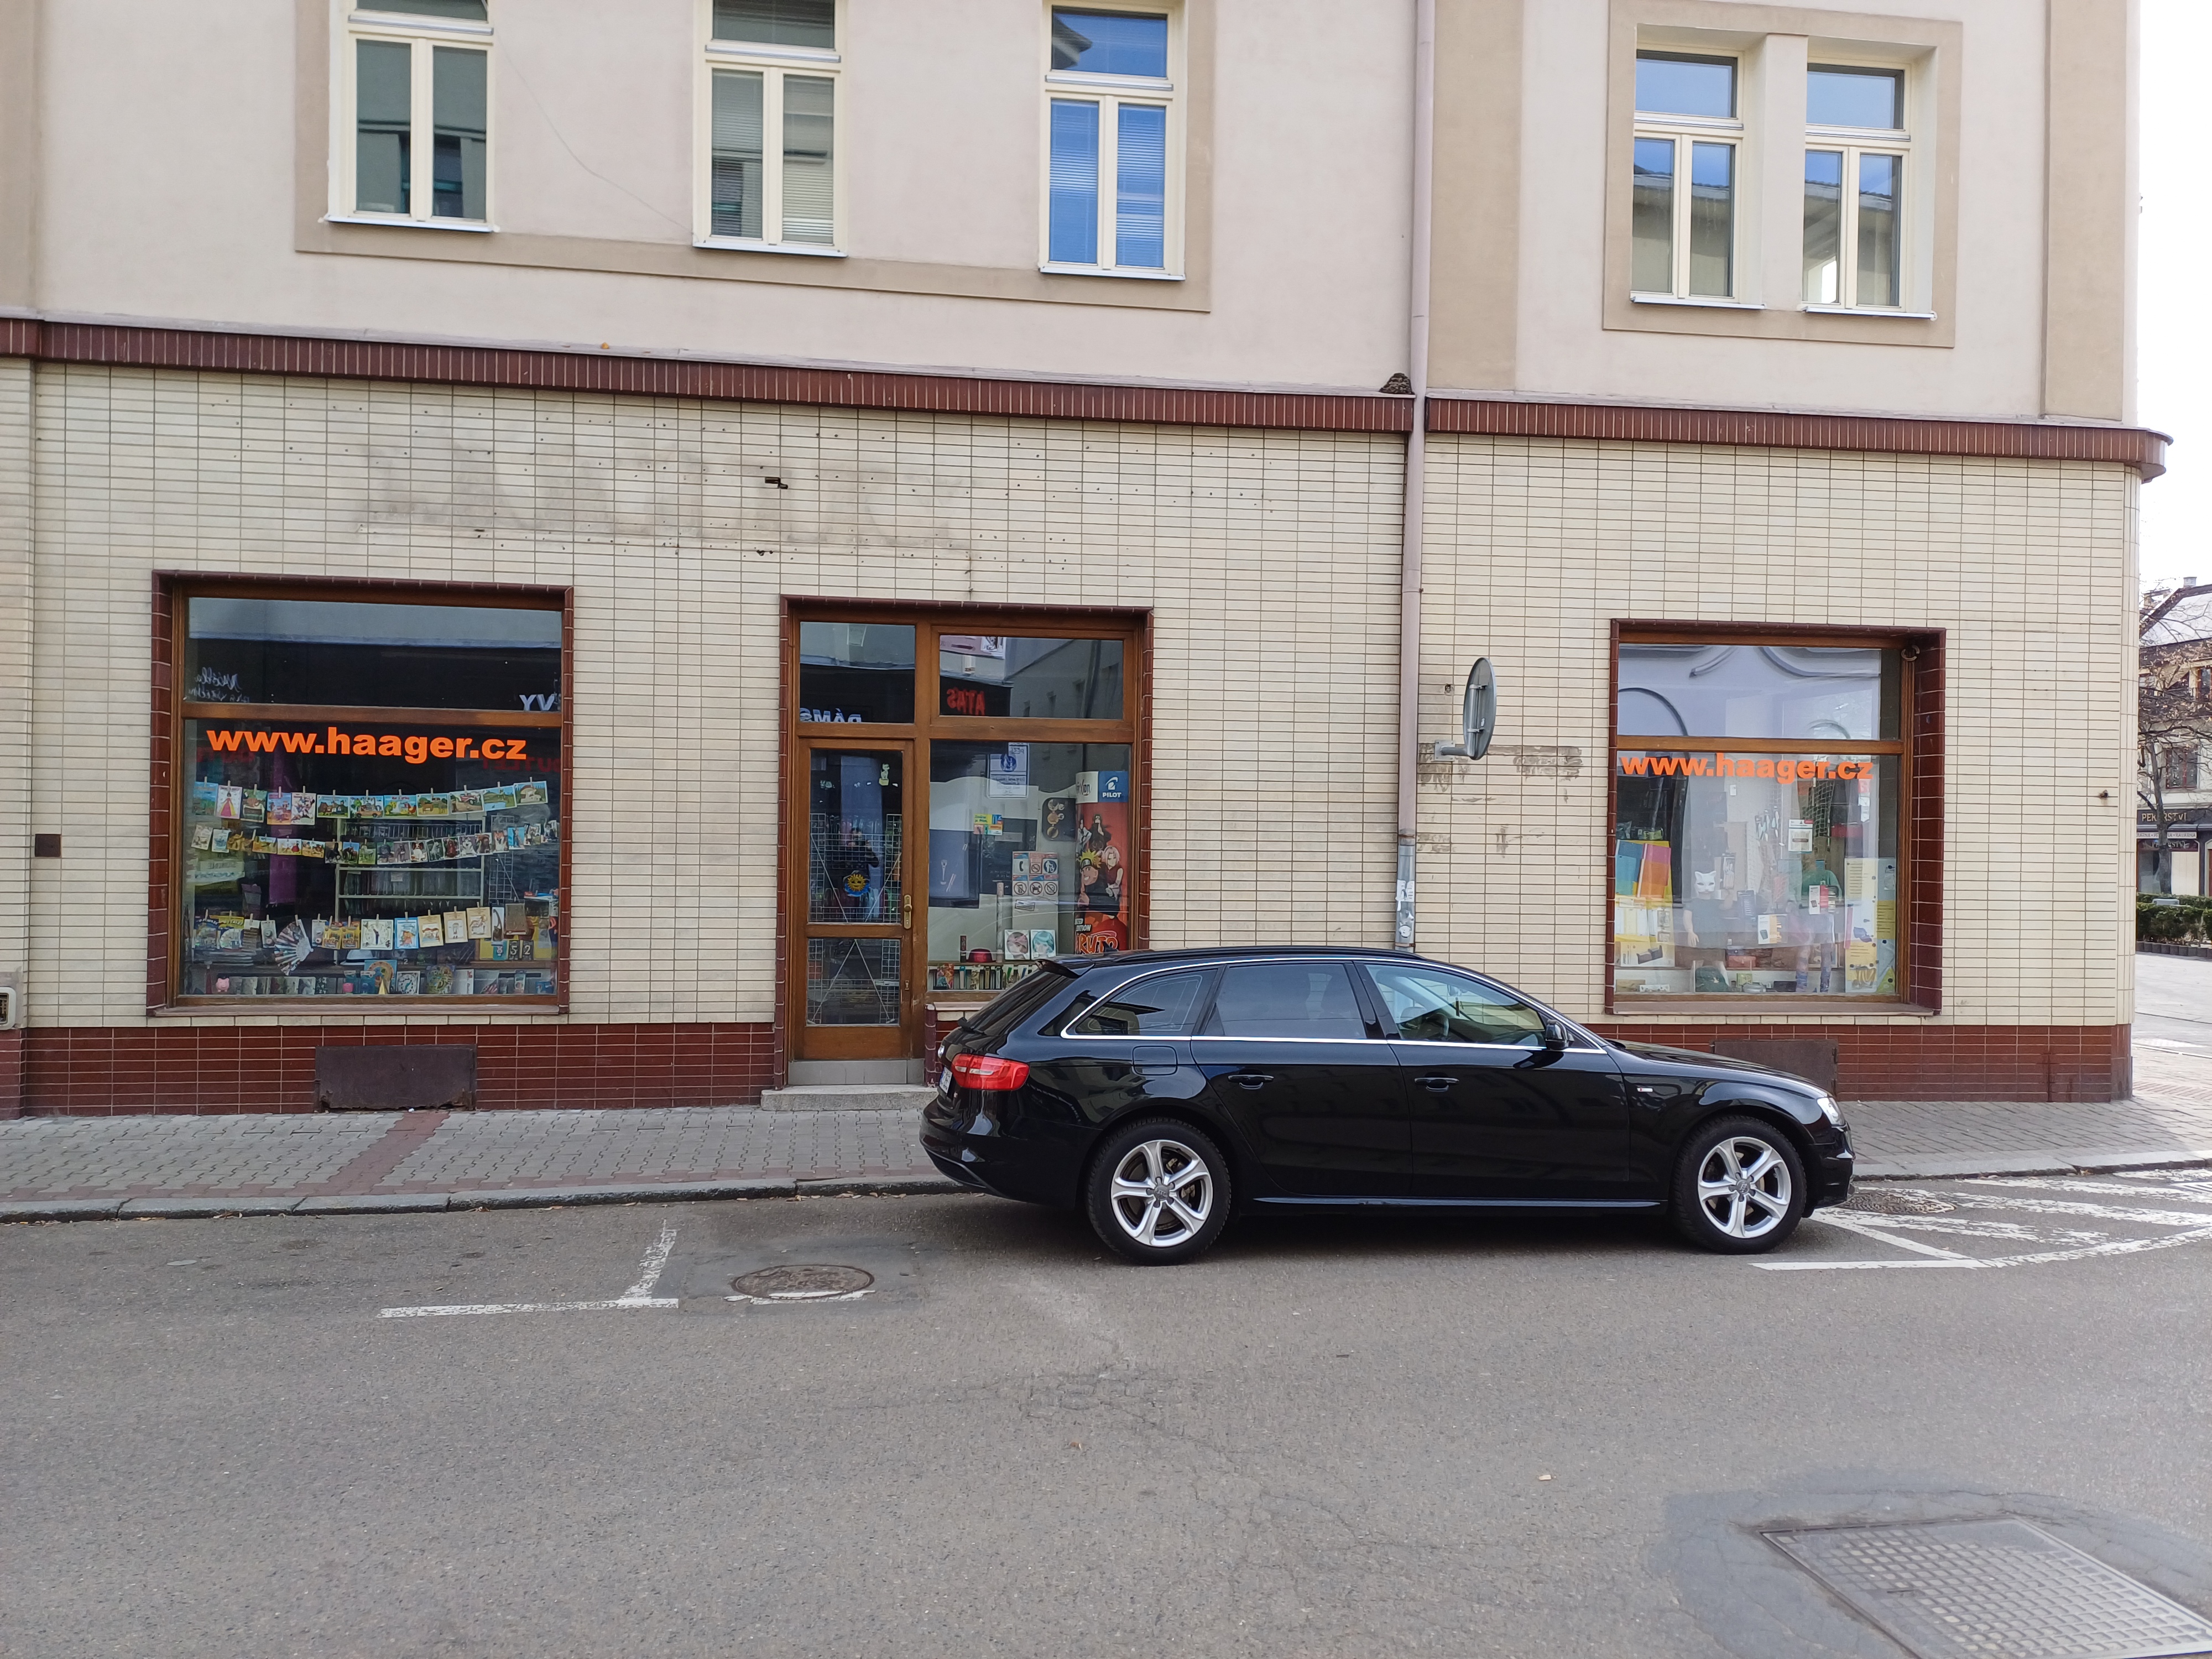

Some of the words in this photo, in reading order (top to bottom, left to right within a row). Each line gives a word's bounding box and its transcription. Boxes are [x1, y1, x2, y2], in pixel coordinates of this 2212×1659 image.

[206, 727, 526, 764] www.haager.cz
[1621, 753, 1873, 784] www.haager.cz
[524, 945, 531, 955] 2
